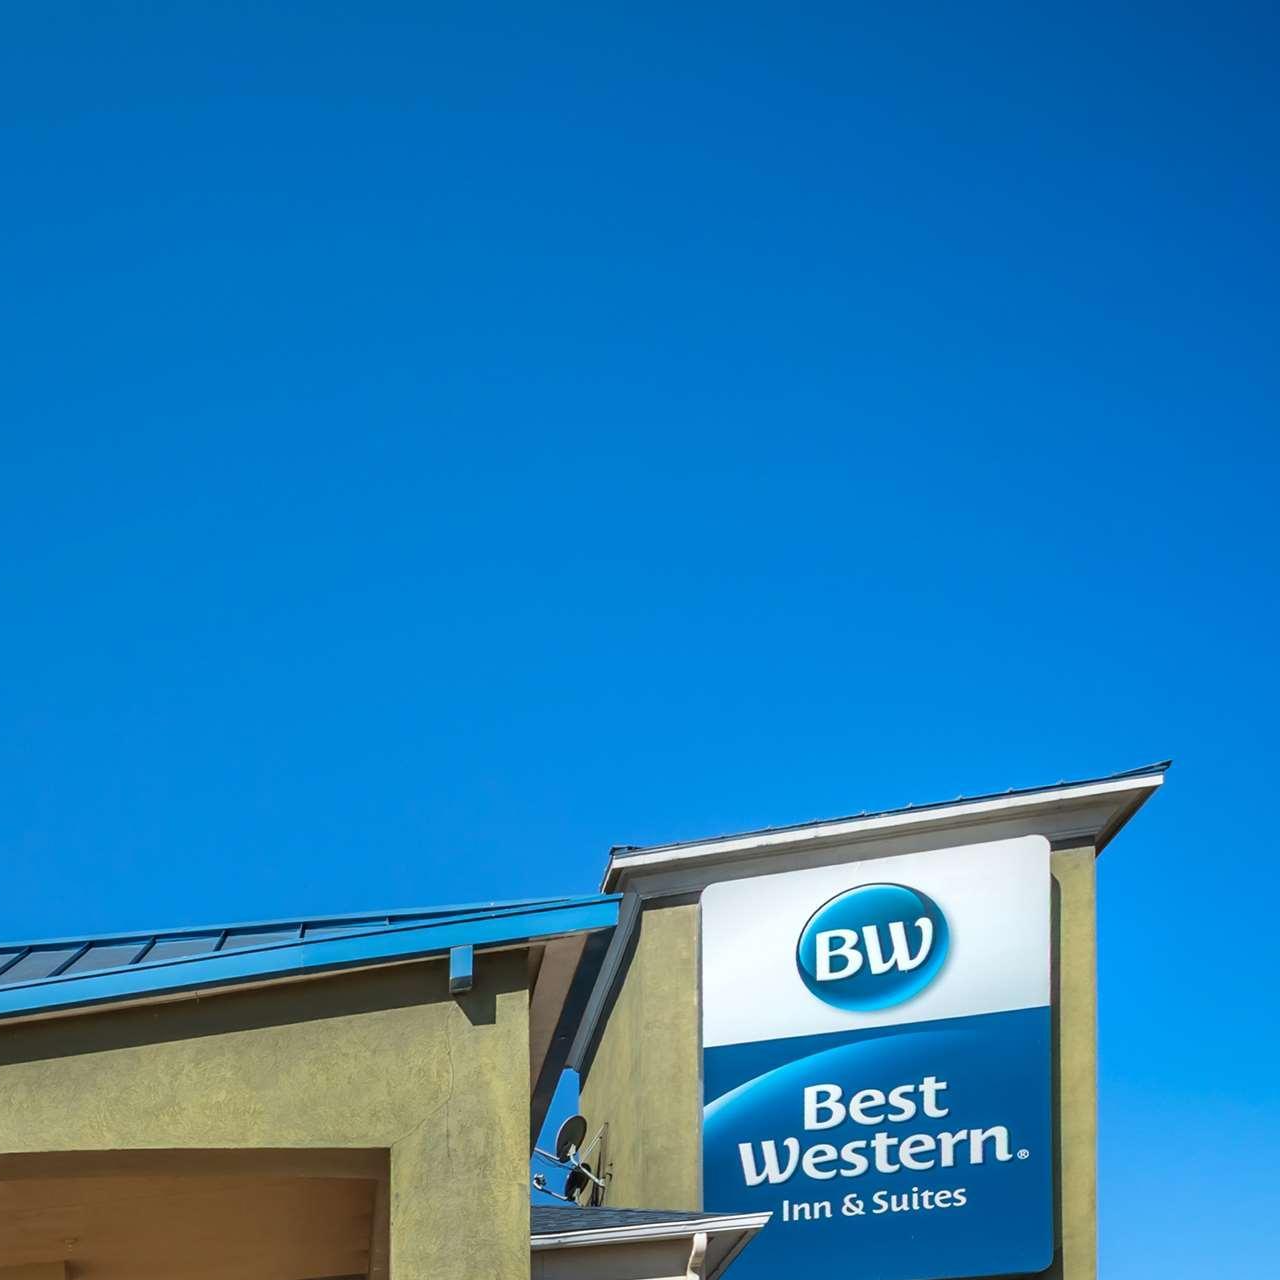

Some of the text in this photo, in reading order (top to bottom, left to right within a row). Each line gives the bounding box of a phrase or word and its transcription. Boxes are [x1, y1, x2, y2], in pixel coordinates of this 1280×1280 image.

[815, 916, 934, 982] BW
[803, 1076, 949, 1131] Best
[782, 1186, 967, 1222] Inn & Suites
